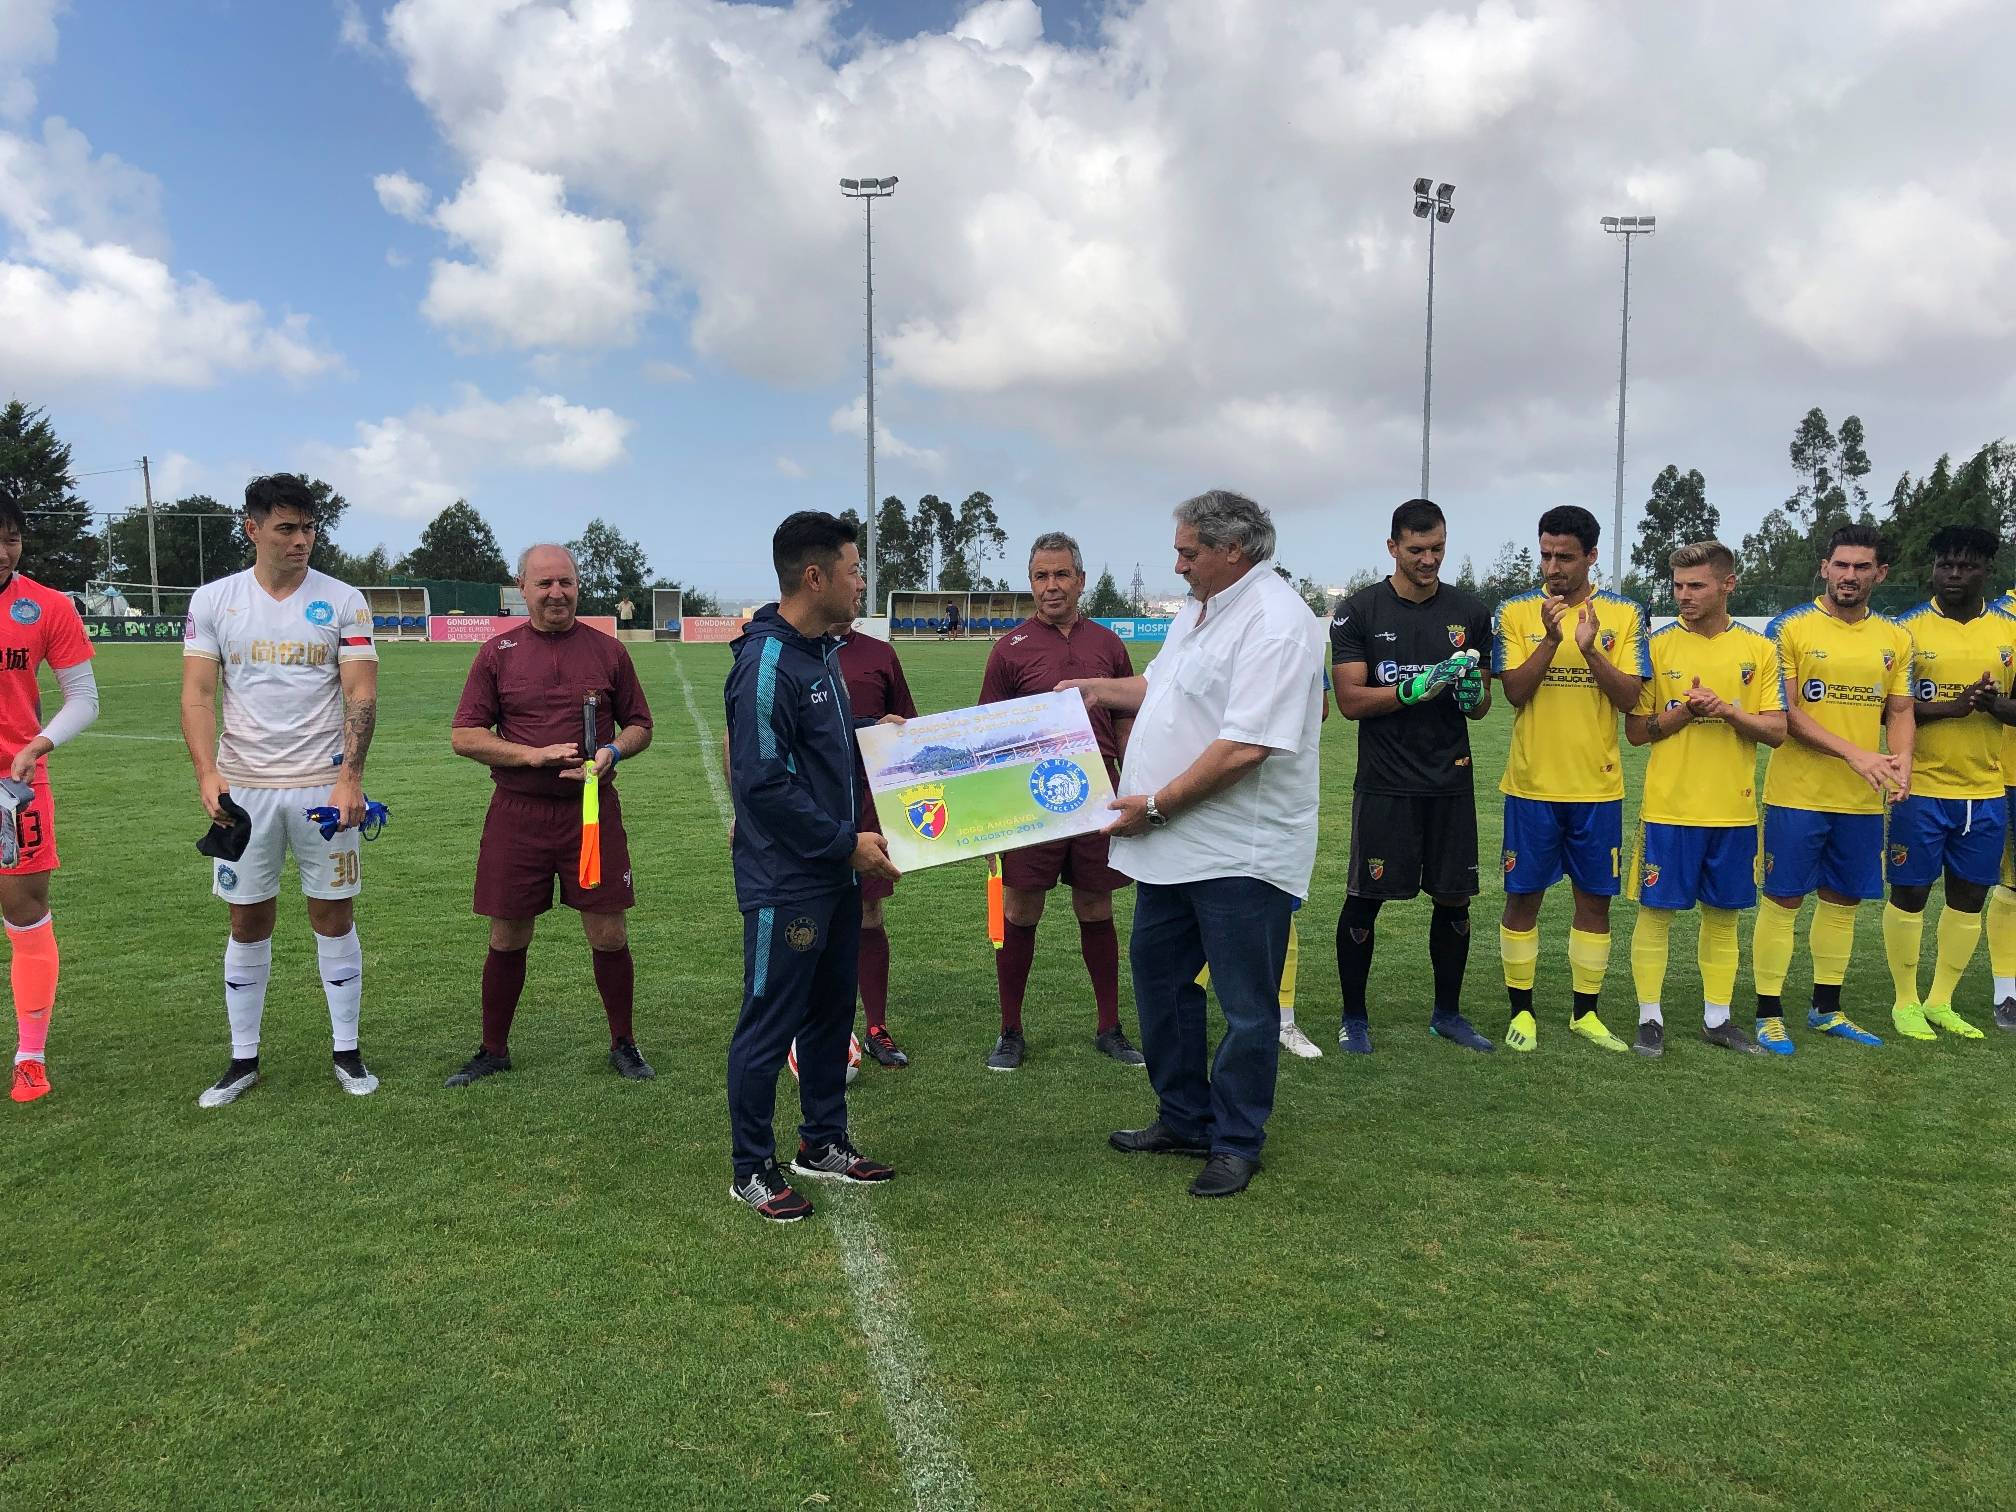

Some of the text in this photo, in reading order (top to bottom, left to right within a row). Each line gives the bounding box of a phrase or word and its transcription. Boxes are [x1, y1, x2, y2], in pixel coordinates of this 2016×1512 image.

[446, 618, 490, 626] GONDOMAR
[694, 619, 736, 627] GONDOMAR
[1399, 664, 1435, 672] AZEVE
[1827, 683, 1874, 693] AZEVEDO
[957, 837, 970, 847] 10
[974, 829, 1014, 843] AGOSTO
[329, 849, 359, 888] 30
